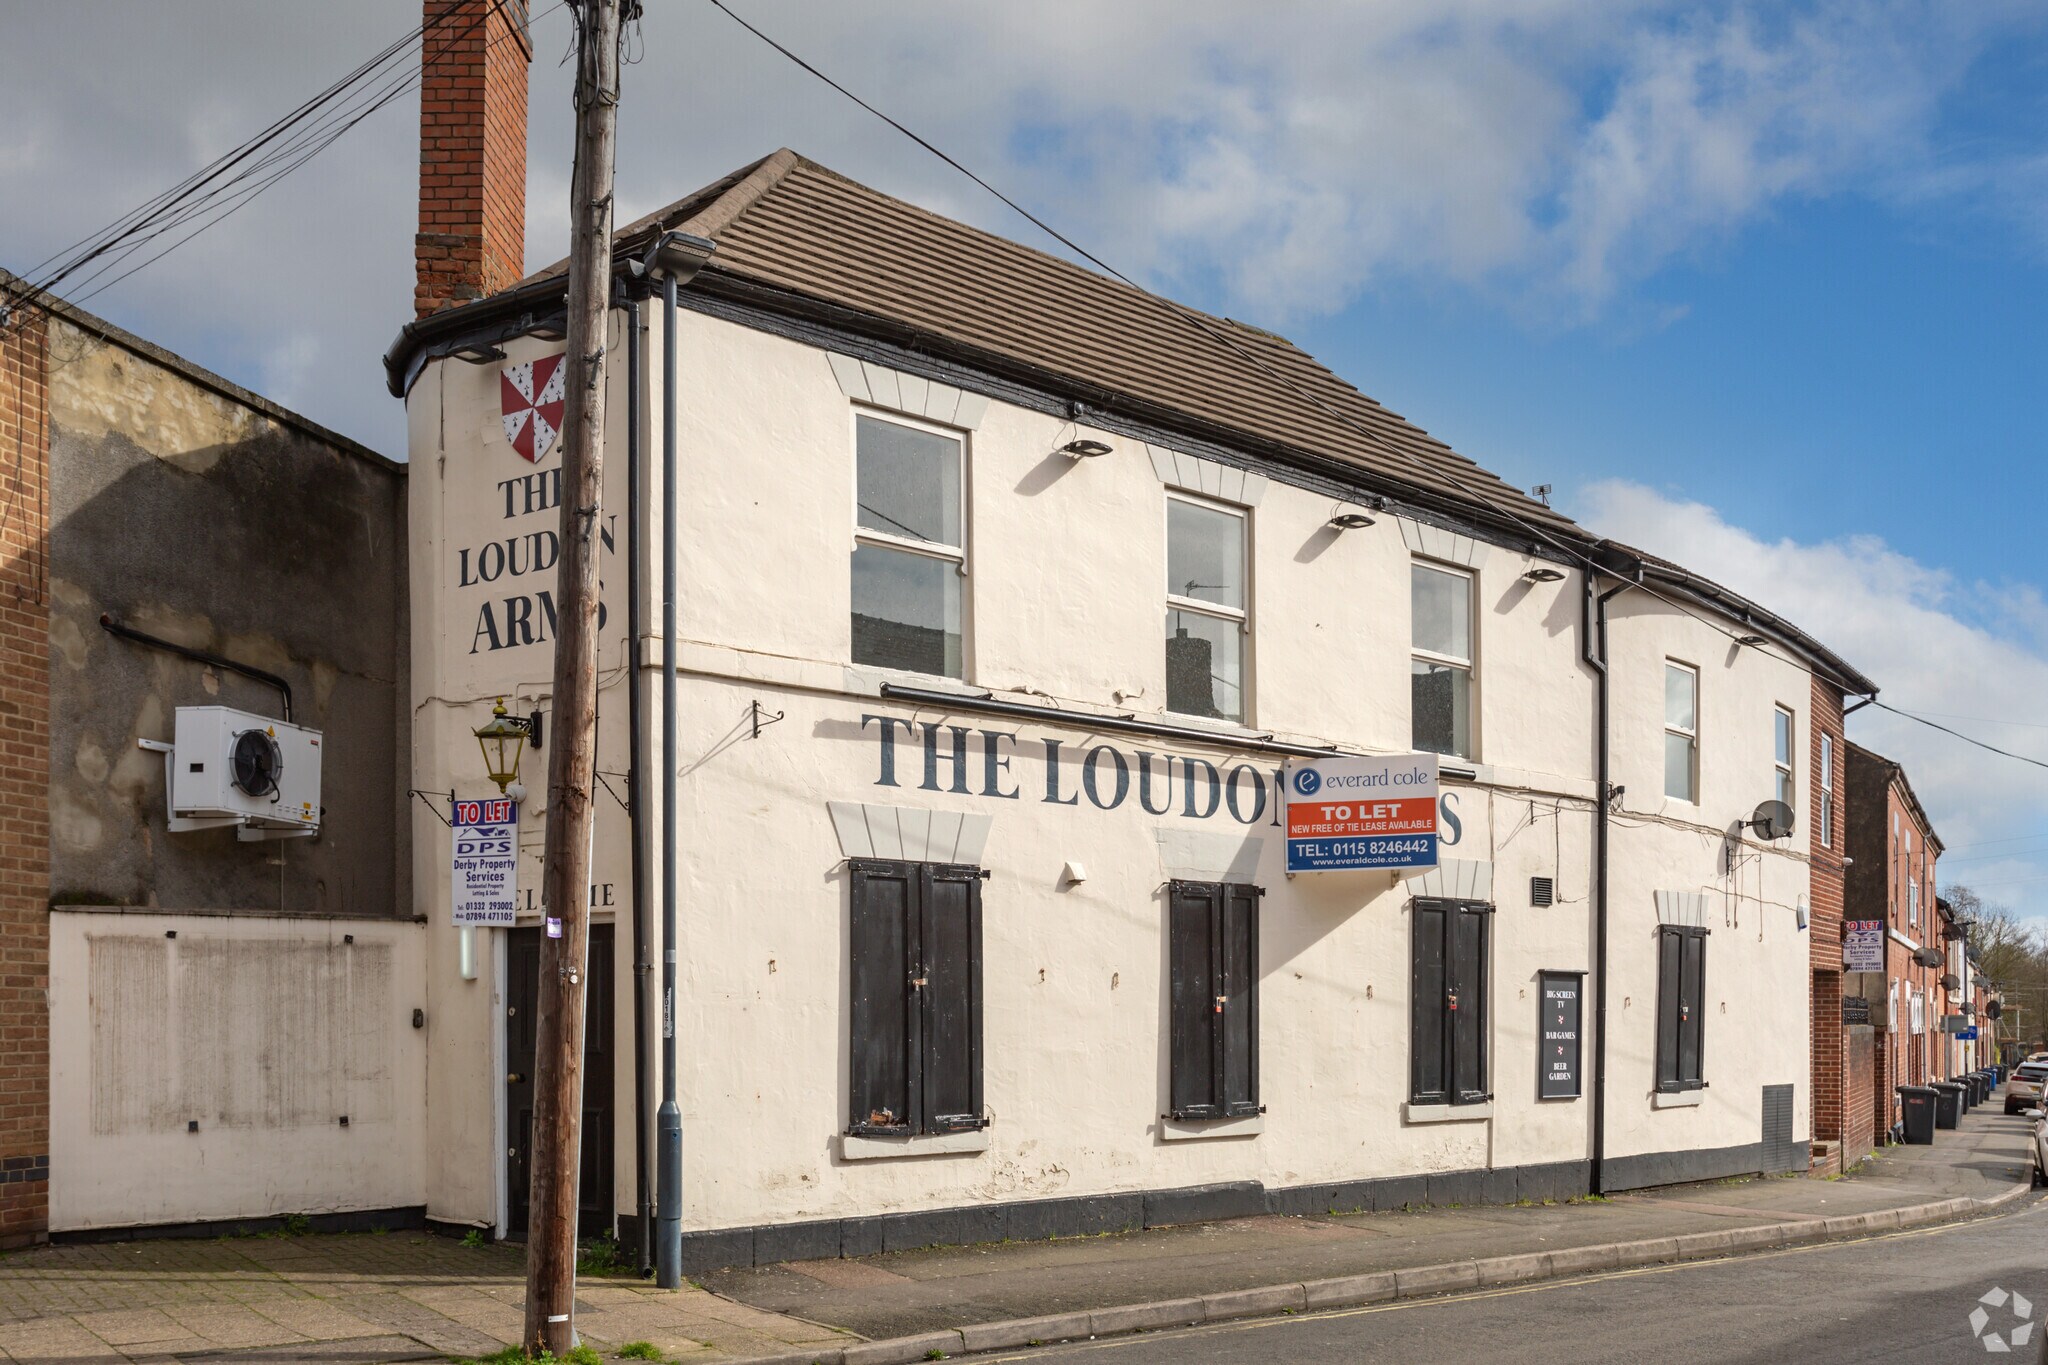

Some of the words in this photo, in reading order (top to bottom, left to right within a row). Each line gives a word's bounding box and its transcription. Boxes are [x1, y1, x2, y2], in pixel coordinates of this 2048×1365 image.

[458, 515, 617, 587] LOUDN
[861, 713, 1020, 800] THE
[1326, 768, 1389, 789] everard
[1393, 767, 1428, 786] cole
[458, 803, 480, 825] TO
[484, 801, 511, 823] LET
[1320, 806, 1352, 821] TO
[1359, 803, 1402, 819] LET
[1291, 824, 1310, 834] NEW
[1311, 823, 1332, 833] FREE
[1334, 823, 1345, 832] OF
[1347, 822, 1359, 832] TIE
[1361, 821, 1387, 831] LEASE
[1388, 819, 1432, 830] AVAILABLE
[457, 841, 511, 854] DPS
[1296, 844, 1328, 857] TEL:
[1333, 842, 1366, 856] 0115
[1369, 839, 1428, 854] 8246442
[454, 859, 477, 872] Derby
[480, 858, 516, 871] Property
[466, 871, 505, 882] Services
[465, 901, 485, 911] 01332
[488, 901, 514, 911] 293002
[465, 912, 486, 921] 07894
[487, 912, 513, 921] 471105
[1861, 921, 1879, 930] LET
[1546, 990, 1556, 999] BIG
[1556, 990, 1576, 999] SCREEN
[1557, 1000, 1565, 1009] TV
[1545, 1031, 1557, 1040] BAR
[1557, 1031, 1576, 1040] GAMES
[1553, 1062, 1567, 1071] BEER
[1548, 1071, 1571, 1081] GARDEN
